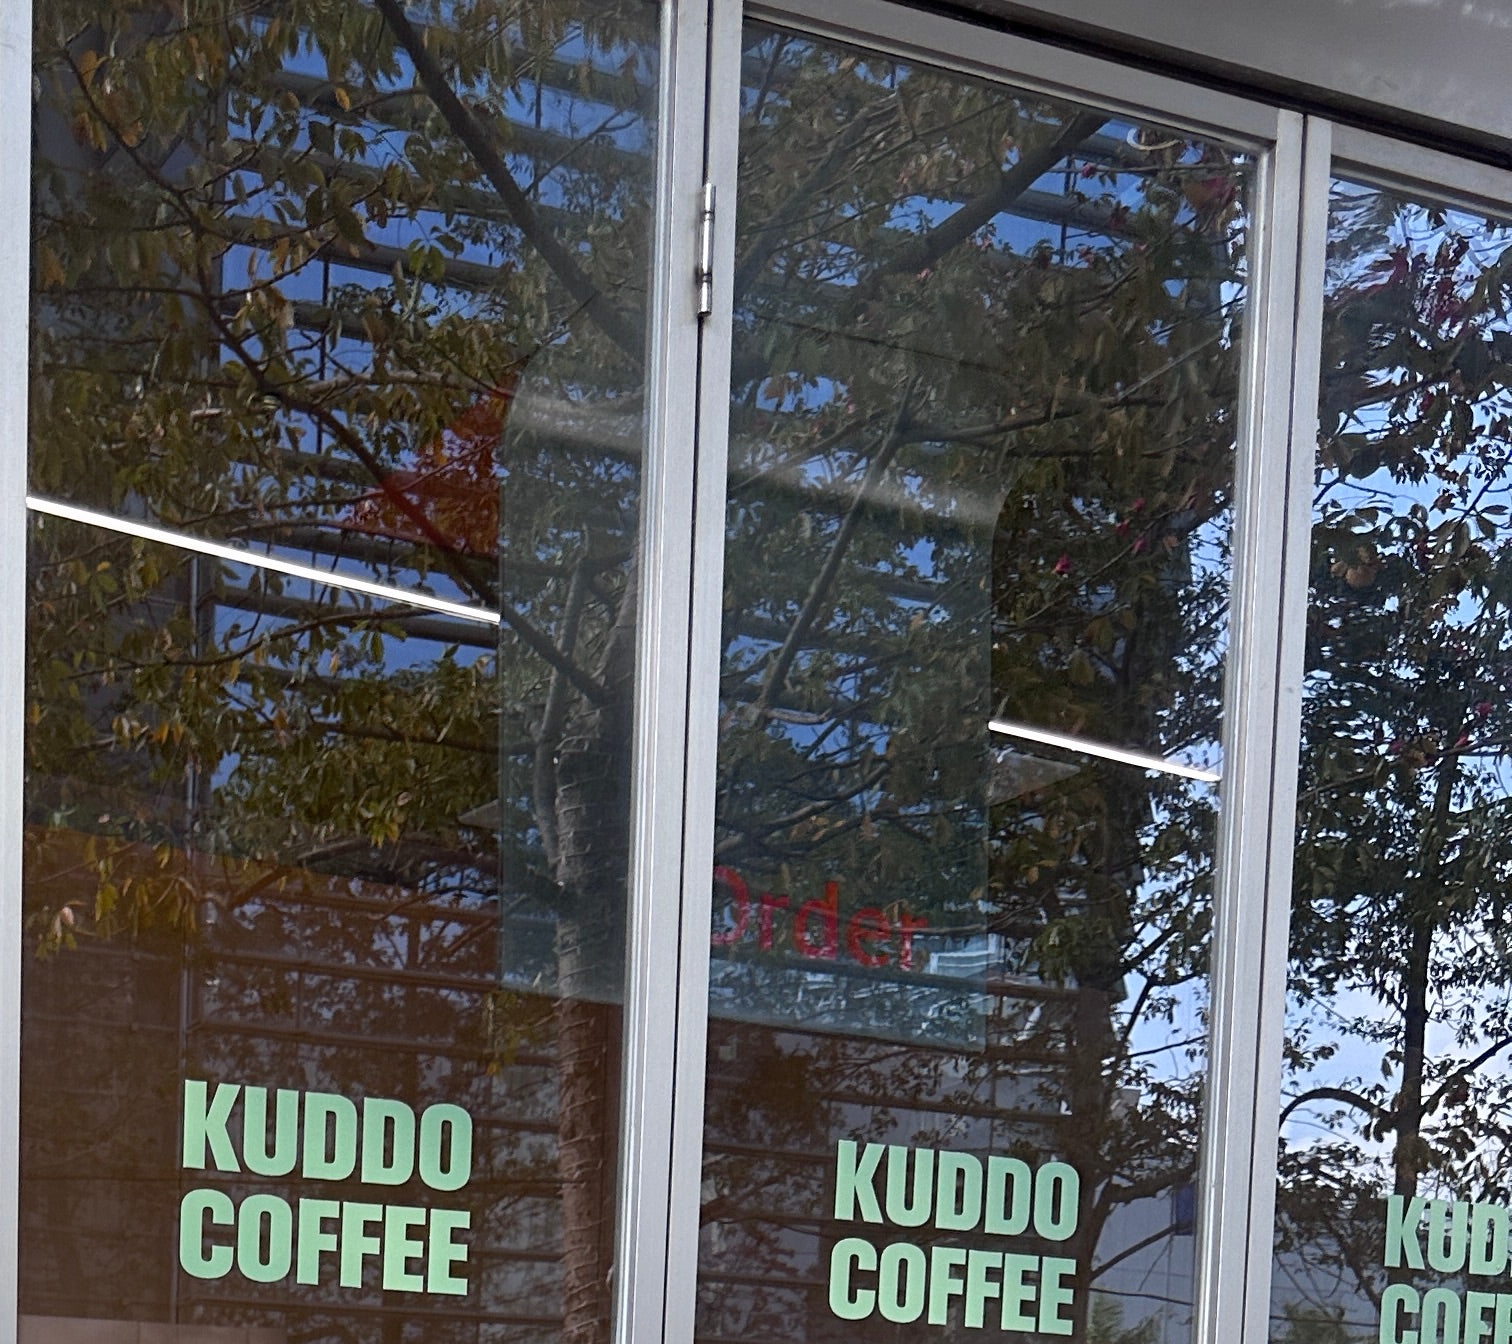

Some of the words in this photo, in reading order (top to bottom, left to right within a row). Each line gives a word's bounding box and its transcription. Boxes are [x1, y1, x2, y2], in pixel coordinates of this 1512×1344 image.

[183, 1080, 473, 1190] KUDDO
[833, 1140, 1081, 1241] KUDDO
[1384, 1194, 1512, 1277] KUD
[179, 1188, 471, 1295] COFFEE
[829, 1237, 1076, 1336] COFFEE
